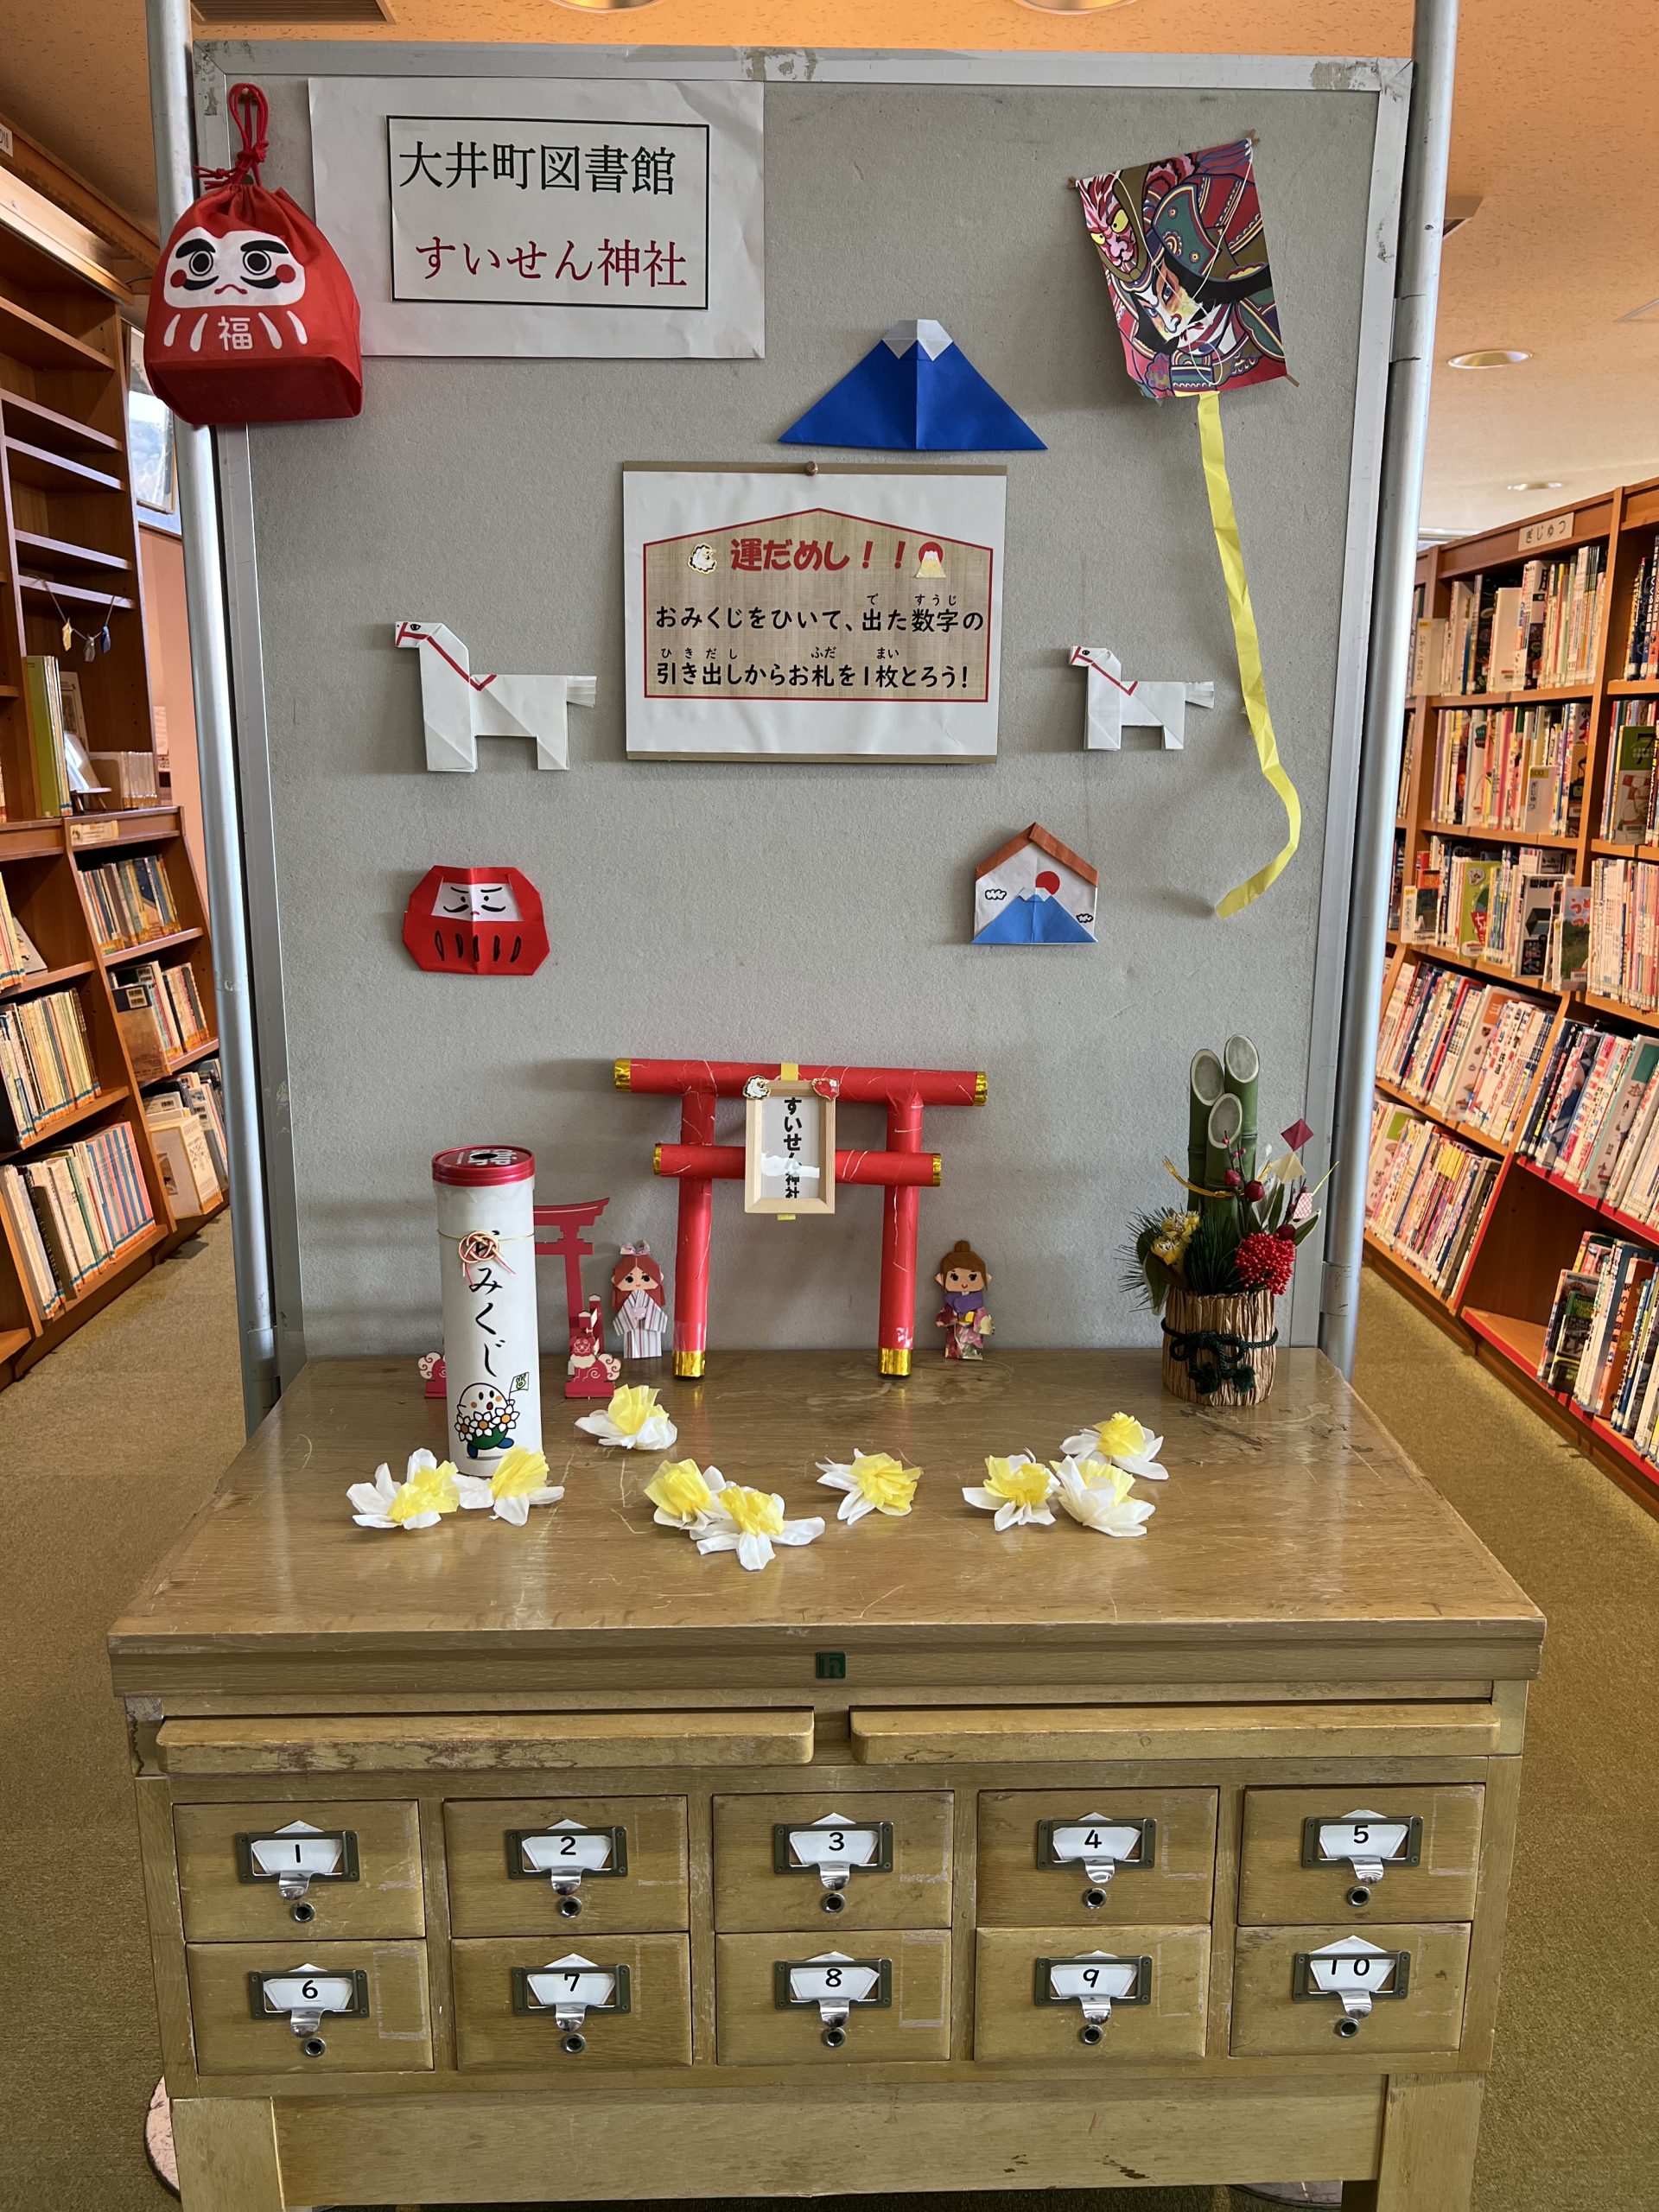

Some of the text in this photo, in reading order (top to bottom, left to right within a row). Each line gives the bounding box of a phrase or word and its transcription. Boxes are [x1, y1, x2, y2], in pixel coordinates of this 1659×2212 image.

[399, 141, 676, 196] 大井町図書館
[416, 236, 687, 289] すいせん神社
[218, 315, 253, 351] 福
[1526, 520, 1566, 543] ぎじゅつ
[730, 538, 906, 571] 運だめし！！
[867, 593, 957, 607] で すうじ
[657, 606, 983, 632] おみくじをひいて、出た数字の
[660, 646, 899, 659] ひきだし ふだ まい
[657, 662, 968, 689] 引き出しからお札を1枚とろう!
[828, 1831, 844, 1852] 3
[1084, 1829, 1103, 1849] 4
[1353, 1824, 1370, 1844] 5
[294, 1843, 302, 1864] 1
[560, 1835, 576, 1856] 2
[826, 1967, 842, 1988] 8
[1083, 1968, 1100, 1988] 9
[1331, 1959, 1370, 1976] 10
[302, 1979, 319, 2000] 6
[564, 1973, 580, 1993] 7
